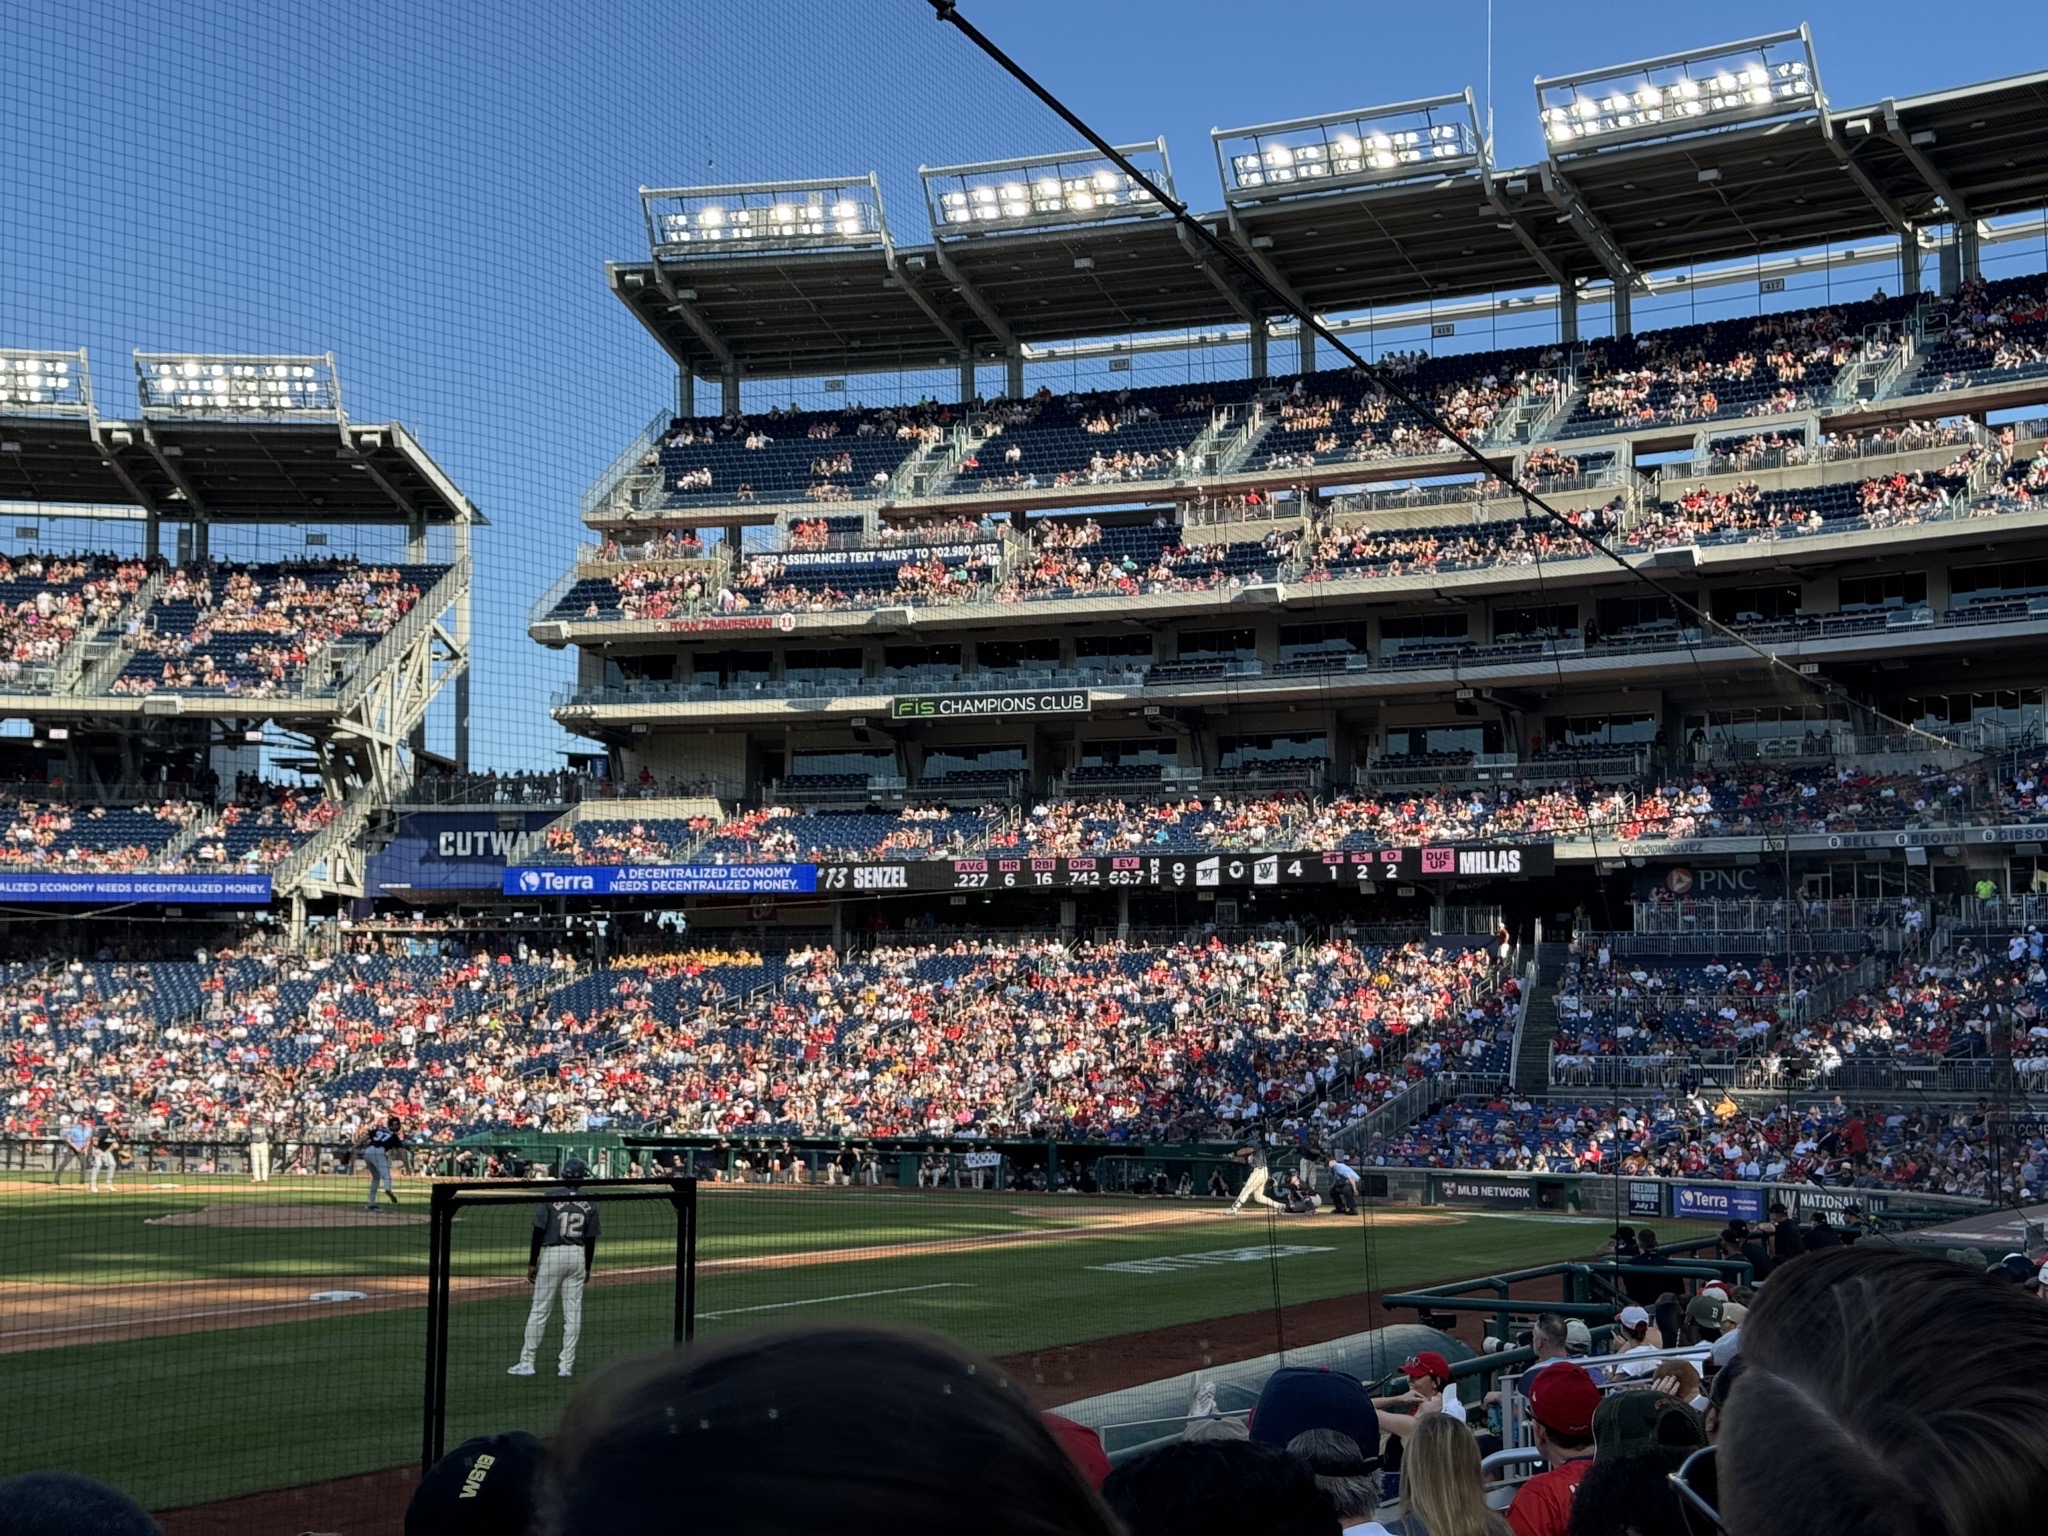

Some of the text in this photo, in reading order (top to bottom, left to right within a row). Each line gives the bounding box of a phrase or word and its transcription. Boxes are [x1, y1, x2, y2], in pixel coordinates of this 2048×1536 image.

[1765, 281, 1781, 290] 417
[781, 553, 847, 565] ASSISTANCE?
[849, 551, 876, 563] TEXT
[915, 548, 929, 559] TO
[670, 620, 699, 632] RYAN
[939, 696, 1036, 714] CHAMPIONS
[1040, 695, 1084, 710] CLUB
[1843, 836, 1878, 847] BELL
[1911, 833, 1966, 845] BROWN
[2000, 829, 2048, 841] GIBSO
[1766, 841, 1782, 849] 126
[1426, 851, 1450, 860] DUE
[1459, 850, 1521, 874] MILLAS
[959, 862, 984, 871] AVG
[1002, 861, 1018, 870] HR
[1034, 860, 1053, 869] RBI
[1071, 860, 1093, 869] OPS
[1118, 859, 1134, 868] EV
[1228, 860, 1244, 879] 0
[1287, 860, 1303, 877] 4
[1430, 860, 1446, 869] UP
[616, 866, 792, 879] A DECENTRALIZED ECONOMY
[853, 866, 908, 889] SENZEL
[1065, 871, 1100, 885] .742
[1329, 865, 1337, 880] 1
[1356, 864, 1368, 879] 2
[1386, 864, 1397, 879] 2
[541, 871, 594, 890] Terra
[609, 878, 799, 892] NEEDS DECENTRALIZED MONEY.
[954, 873, 989, 887] .227
[1004, 873, 1015, 886] 6
[1034, 872, 1053, 885] 16
[1698, 869, 1756, 891] PNC
[40, 882, 94, 893] ECONOMY
[97, 882, 131, 893] NEEDS
[134, 883, 222, 893] DECENTRALIZED
[225, 884, 266, 894] MONEY.
[1458, 1185, 1479, 1196] MLB
[1481, 1186, 1531, 1198] NETWORK
[1635, 1202, 1649, 1210] July
[1693, 1191, 1728, 1208] Terra
[557, 1212, 585, 1237] 12
[1711, 1307, 1719, 1318] B
